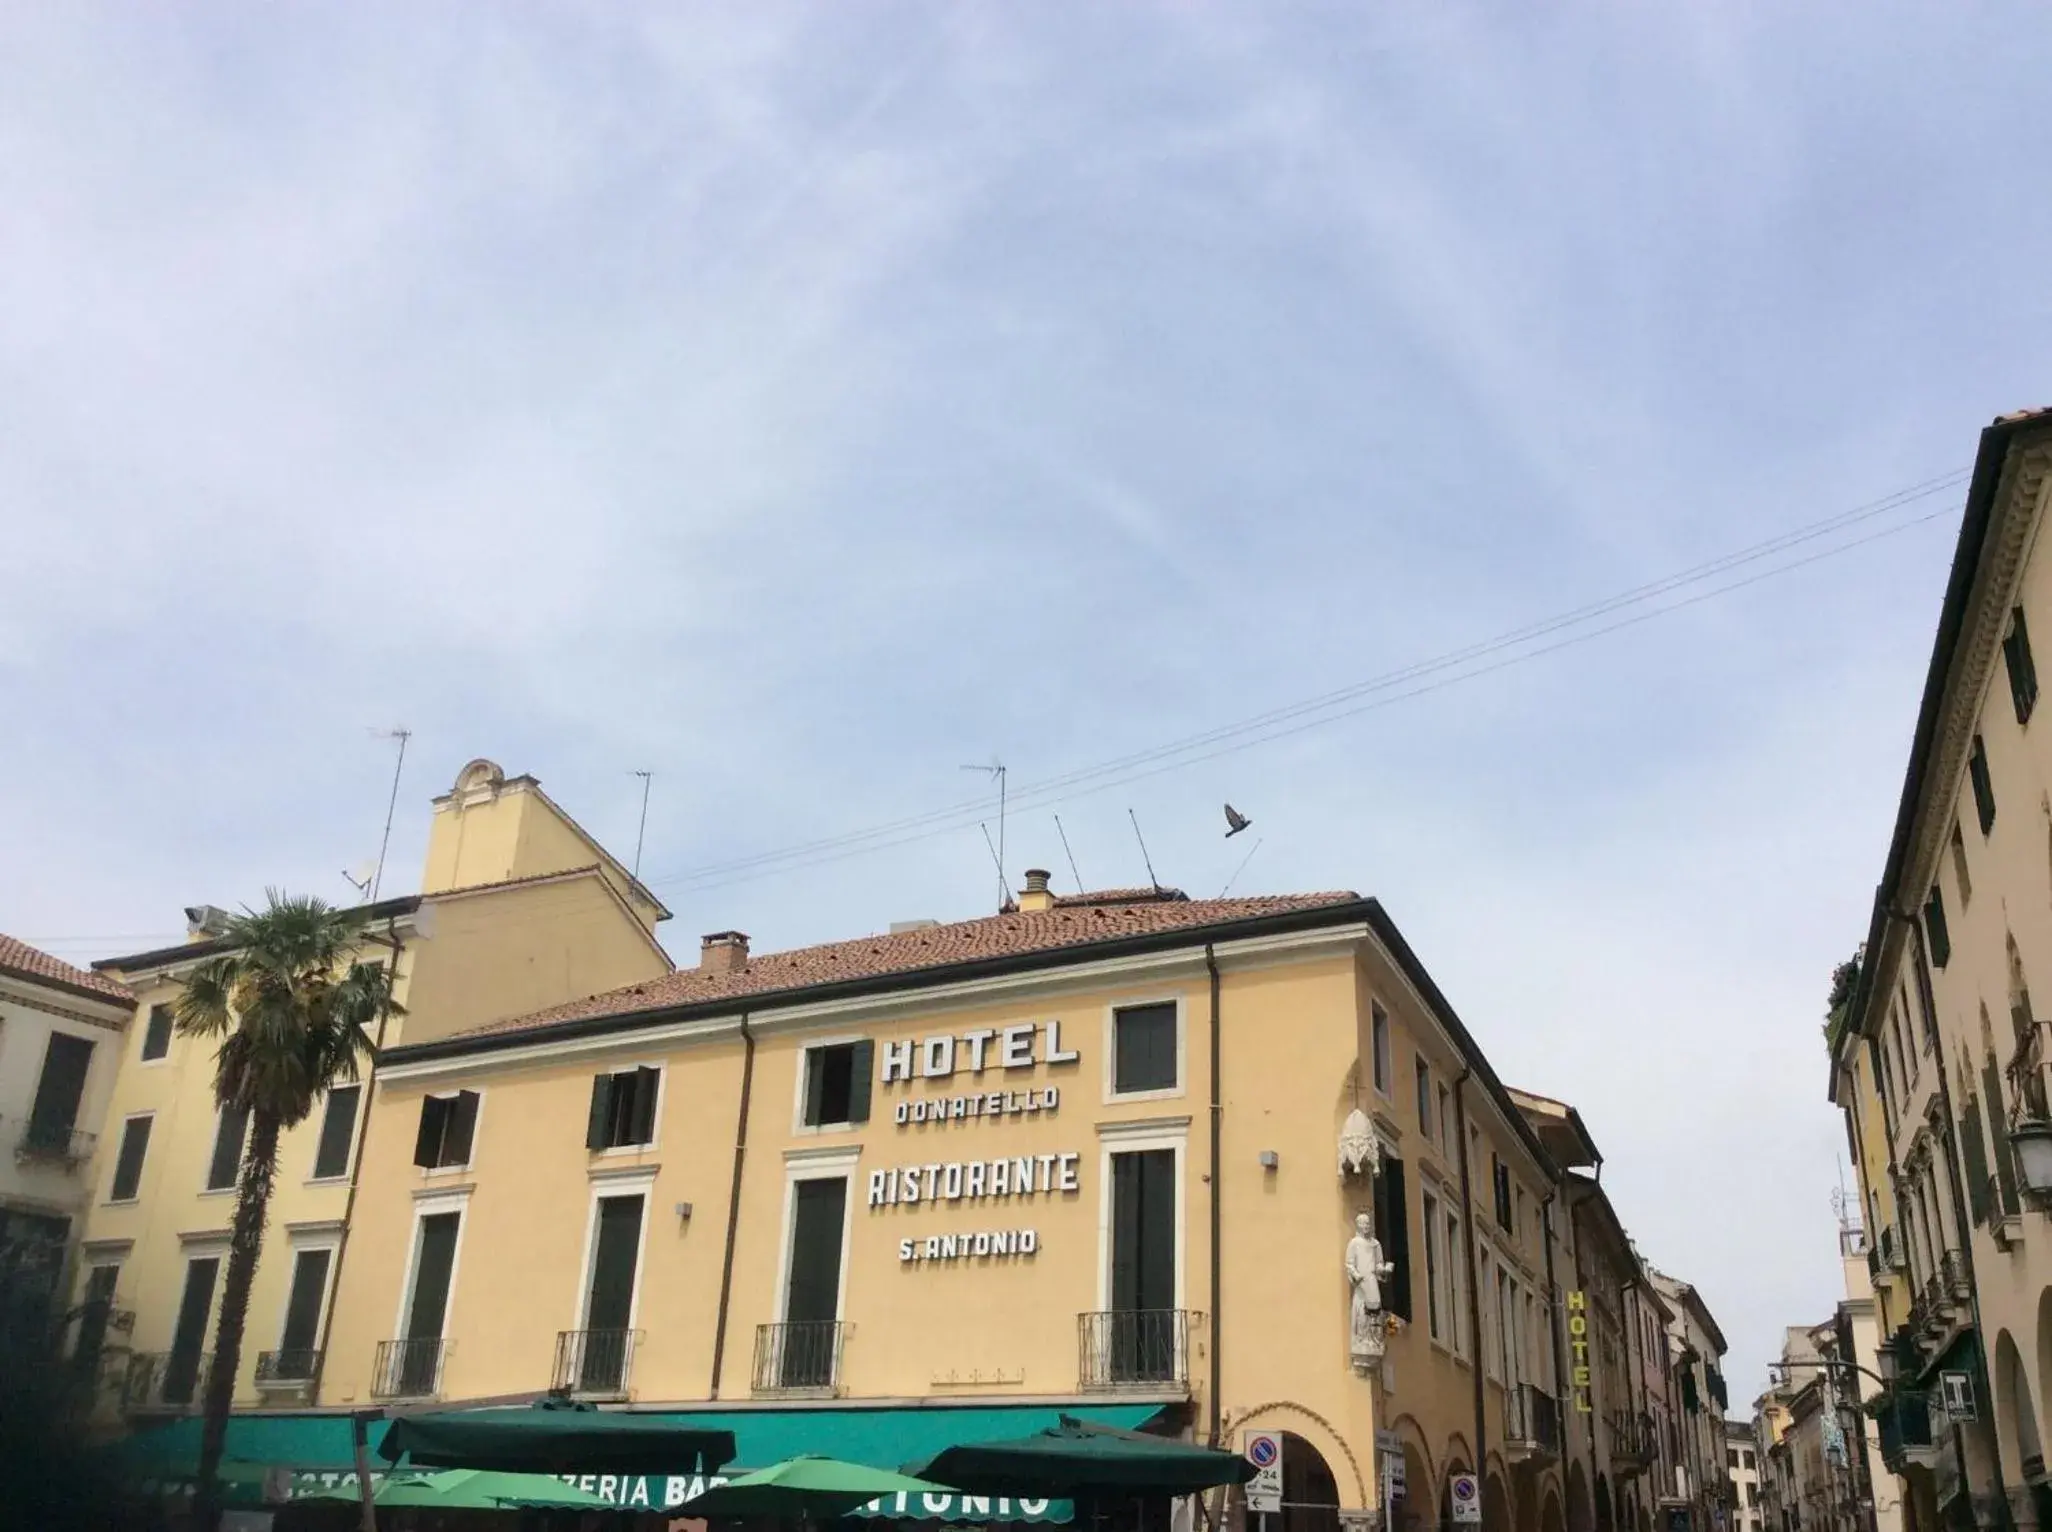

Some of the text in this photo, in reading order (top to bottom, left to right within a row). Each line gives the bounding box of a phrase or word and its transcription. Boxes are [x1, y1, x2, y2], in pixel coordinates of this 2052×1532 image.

[882, 1020, 1079, 1082] HOTEL
[895, 1086, 1058, 1124] DONATELLO
[868, 1152, 1079, 1206] RISTORANTE
[1567, 1290, 1593, 1413] HOTEL
